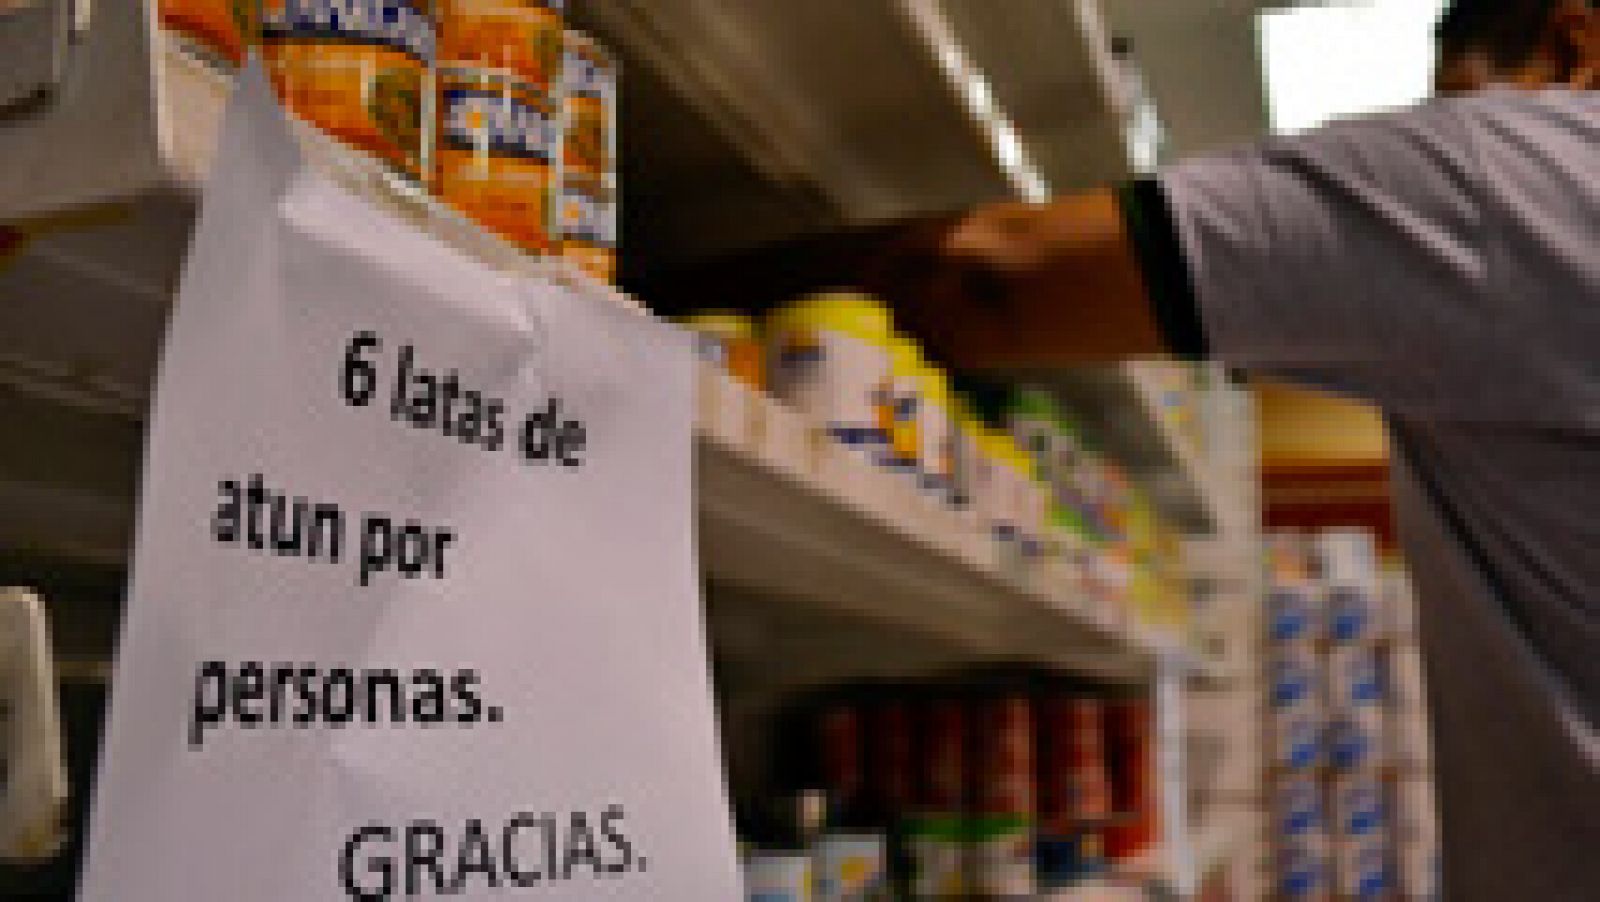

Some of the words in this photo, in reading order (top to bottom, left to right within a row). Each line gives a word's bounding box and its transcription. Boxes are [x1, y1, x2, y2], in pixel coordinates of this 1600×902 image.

[339, 331, 380, 407] 6
[391, 345, 504, 452] latas
[518, 392, 587, 467] de
[211, 474, 346, 564] atun
[359, 511, 456, 586] por
[188, 661, 504, 750] personas.
[338, 804, 648, 902] GRACIAS.
